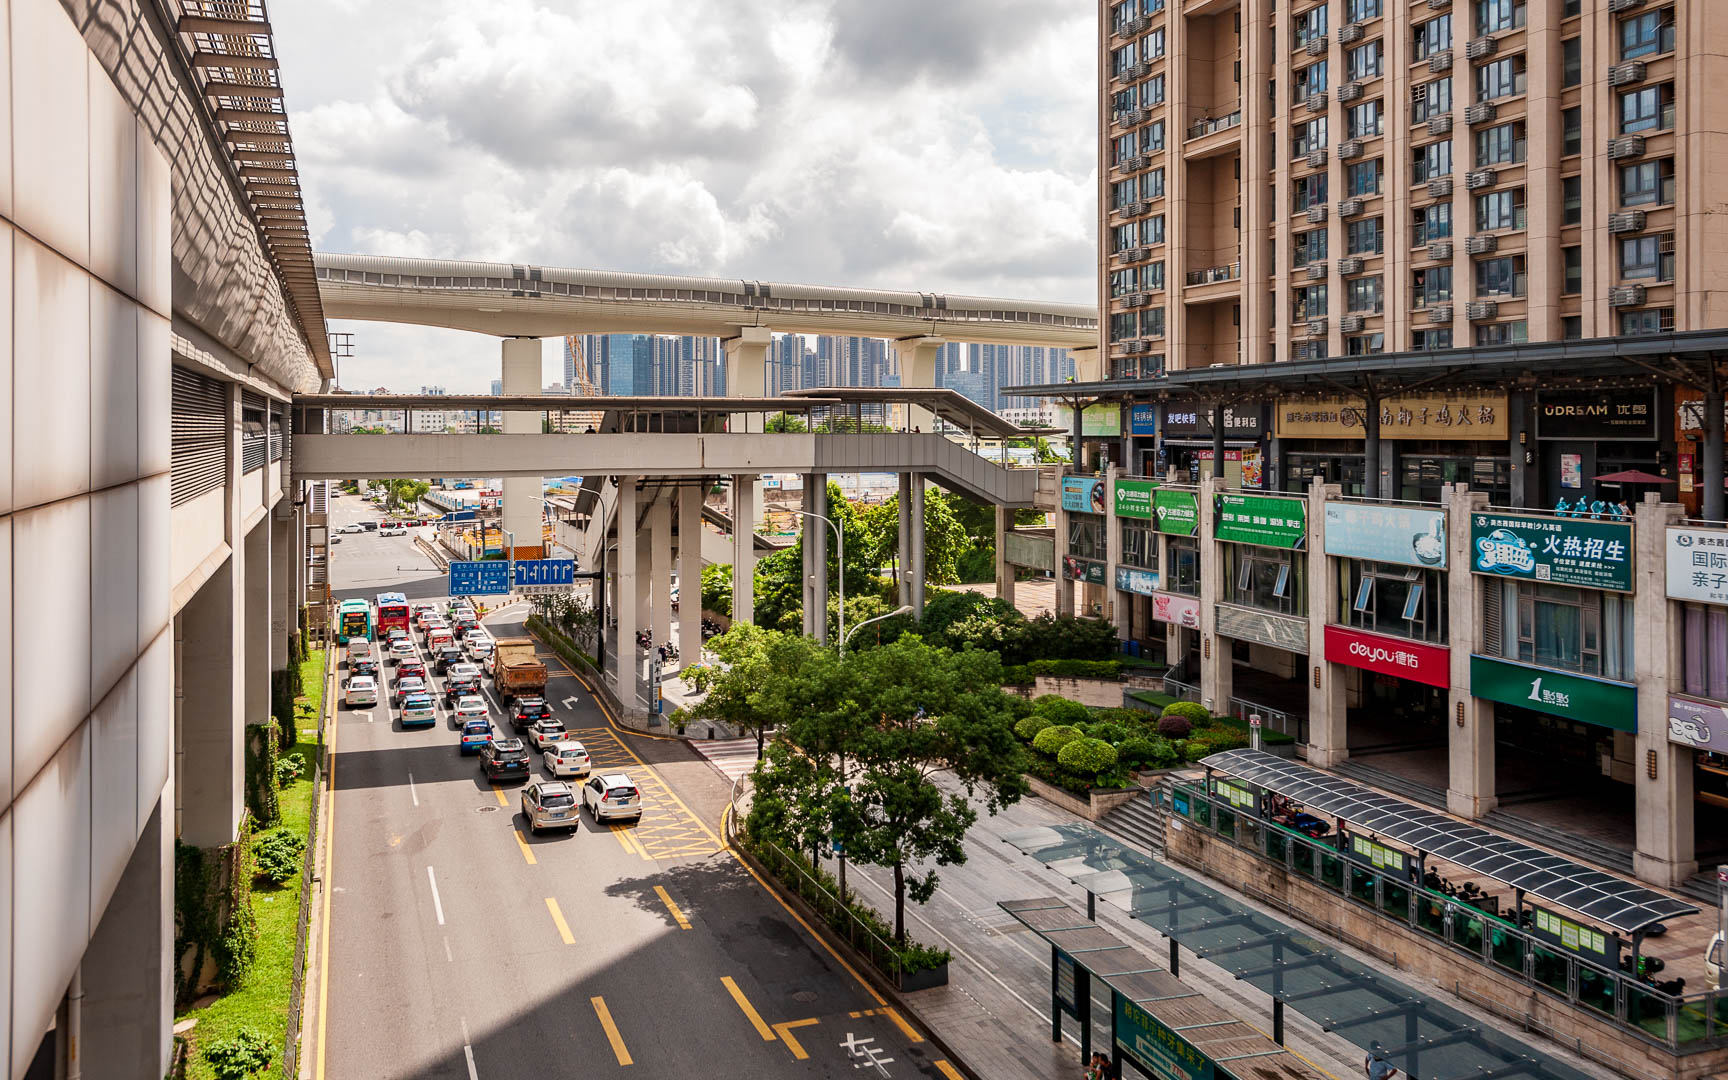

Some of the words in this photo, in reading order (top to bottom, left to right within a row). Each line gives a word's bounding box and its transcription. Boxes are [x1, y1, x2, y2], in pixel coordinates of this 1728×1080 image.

[1357, 404, 1495, 427] 南椰子鸡火锅
[1542, 534, 1625, 562] 火热招生
[1692, 550, 1728, 569] 国际
[1692, 571, 1728, 589] 亲子
